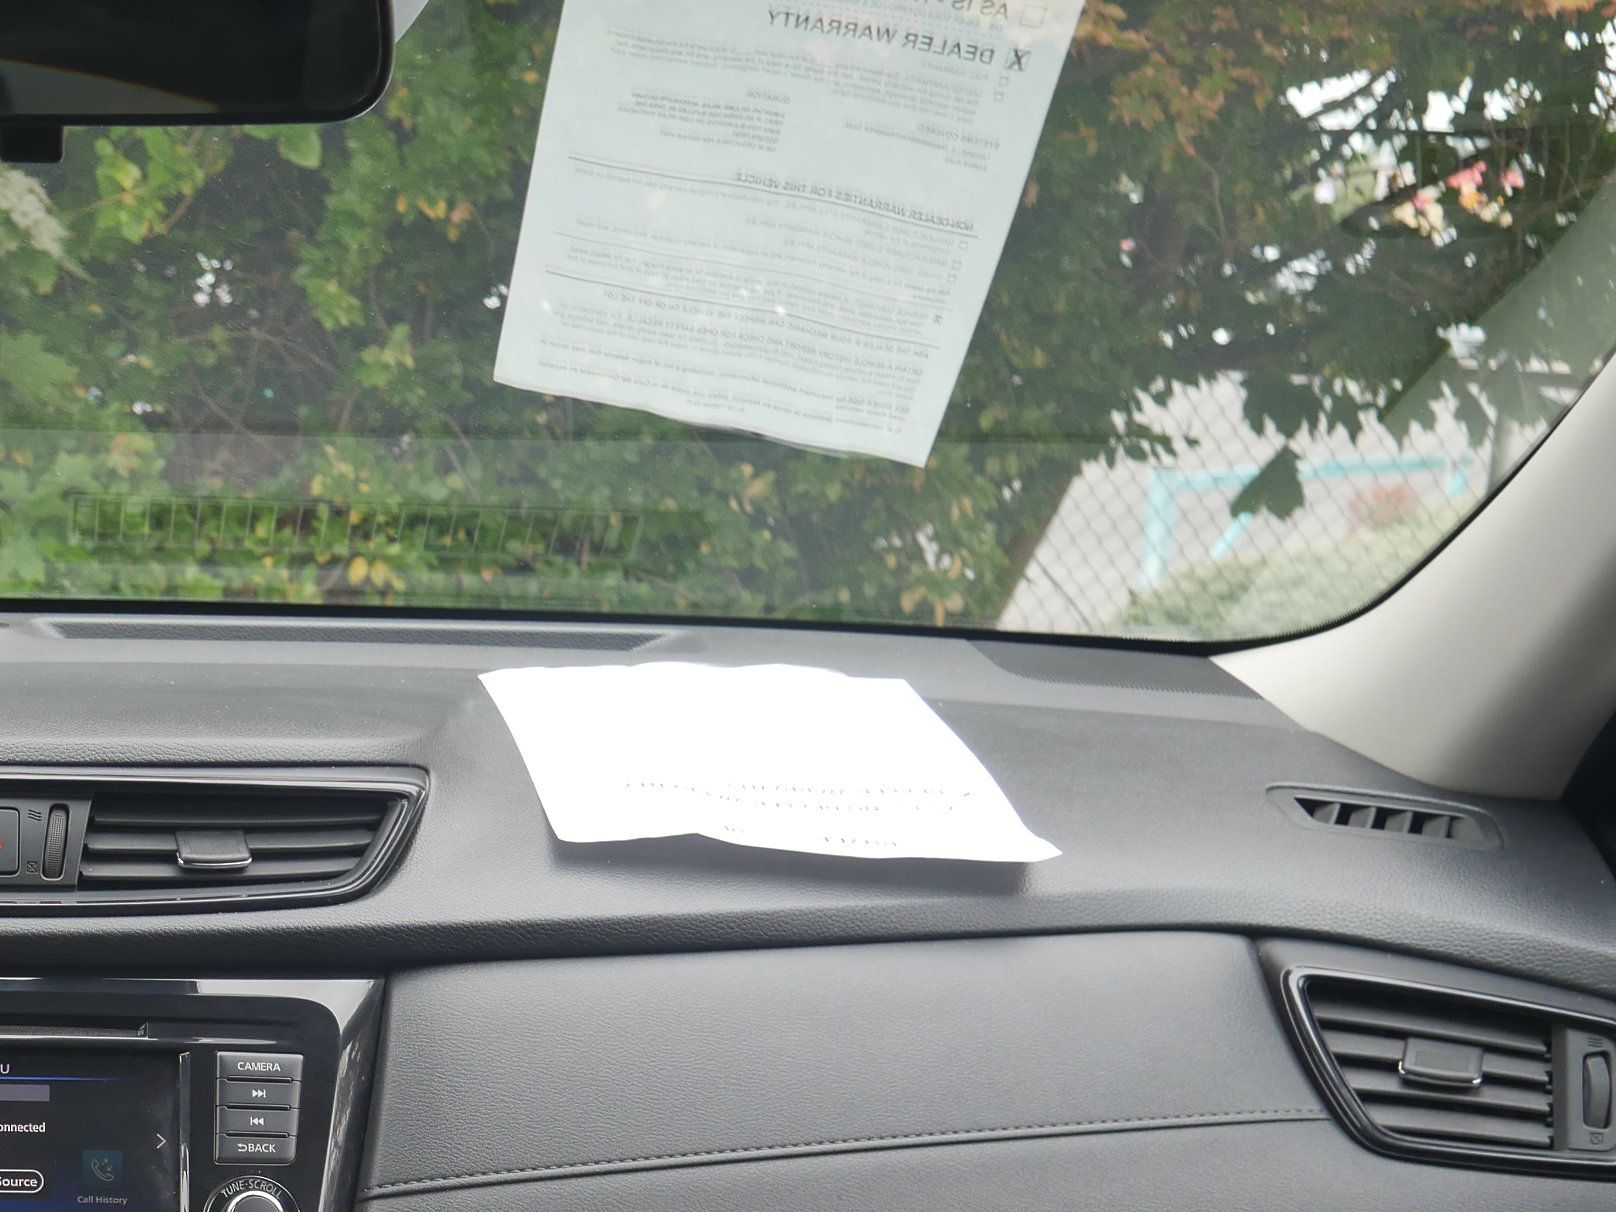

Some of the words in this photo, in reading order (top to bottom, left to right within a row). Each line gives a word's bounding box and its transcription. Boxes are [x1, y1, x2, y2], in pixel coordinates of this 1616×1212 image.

[237, 1061, 282, 1073] CAMERA
[248, 1143, 276, 1153] BACK
[77, 1195, 94, 1205] Call
[95, 1195, 128, 1206] History
